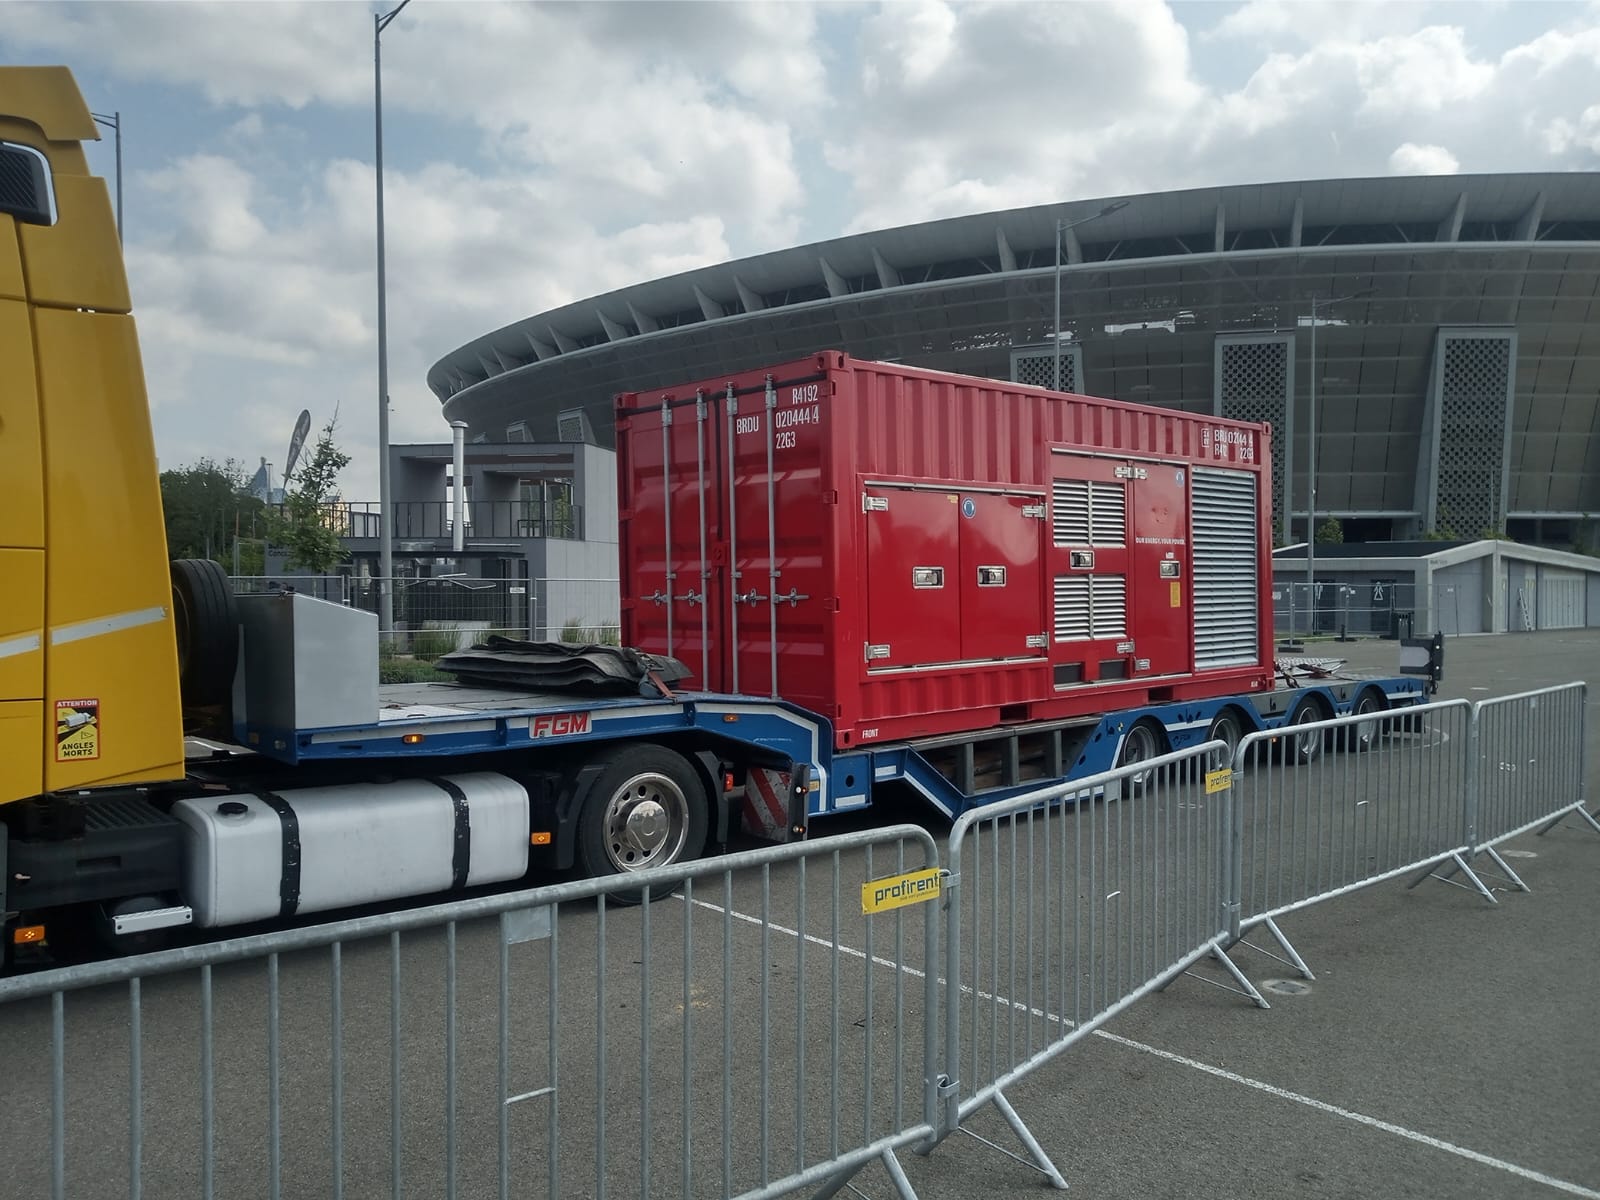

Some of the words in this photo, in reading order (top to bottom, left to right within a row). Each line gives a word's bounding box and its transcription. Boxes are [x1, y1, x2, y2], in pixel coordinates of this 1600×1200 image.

[792, 385, 818, 405] R4192
[736, 416, 759, 434] BRDU
[775, 407, 810, 428] 020444
[776, 431, 796, 449] 22G3
[57, 700, 97, 708] ATTENTION
[534, 711, 588, 737] FGM
[862, 728, 879, 739] FRONT
[61, 741, 94, 750] ANGLES
[63, 749, 93, 757] MORTS
[875, 872, 940, 906] profirent
